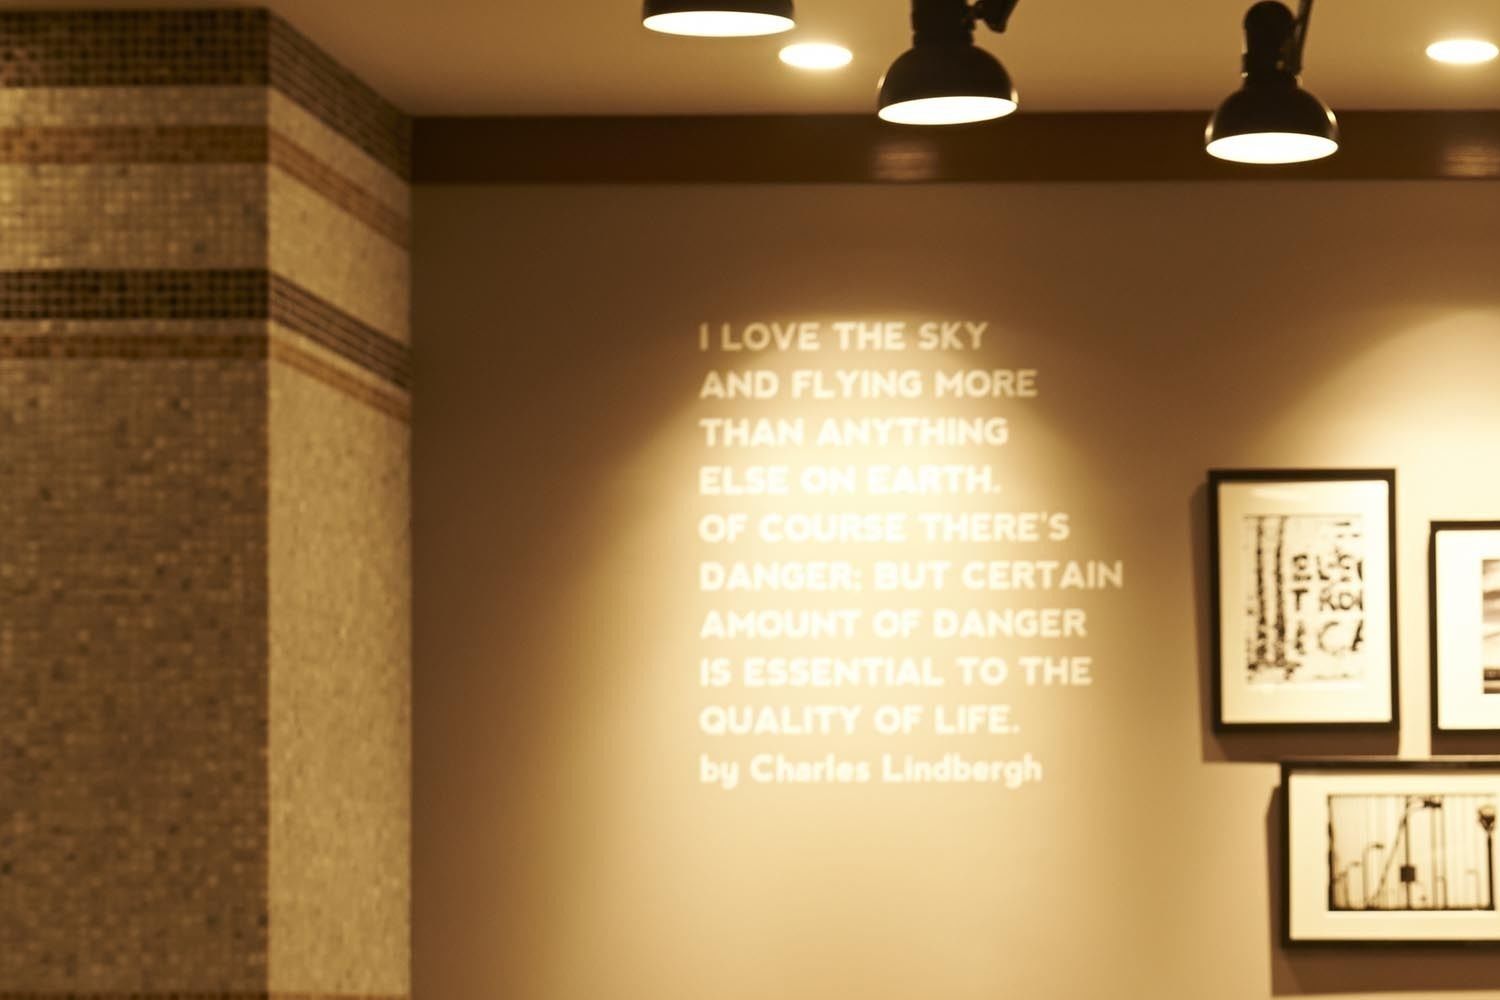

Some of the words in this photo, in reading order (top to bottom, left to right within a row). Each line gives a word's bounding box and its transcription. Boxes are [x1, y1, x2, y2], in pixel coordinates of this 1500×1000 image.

[699, 322, 709, 351] I
[721, 321, 821, 351] LOVE
[832, 320, 906, 352] THE
[918, 321, 989, 351] SKY
[700, 370, 780, 400] AND
[791, 368, 923, 400] FLYING
[934, 368, 1039, 398] MORE
[698, 416, 805, 448] THAN
[815, 416, 1009, 448] ANYTHING
[699, 464, 791, 497] ELSE
[798, 464, 857, 496] ON
[865, 463, 1001, 496] EARTH.
[697, 512, 749, 544] OF
[756, 511, 908, 545] COURSE
[916, 511, 1071, 543] THERE'S
[873, 559, 953, 591] BUT
[960, 559, 1124, 591] CERTAIN
[699, 608, 863, 640] AMOUNT
[871, 607, 924, 640] OF
[932, 607, 1088, 639] DANGER
[699, 656, 733, 688] IS
[743, 655, 945, 688] ESSENTIAL
[954, 656, 1009, 687] TO
[1017, 655, 1094, 687] THE
[698, 704, 862, 736] QUALITY
[872, 703, 924, 736] OF
[934, 704, 1022, 736] LIFE.
[699, 752, 740, 791] by
[748, 752, 871, 785] Charles
[881, 752, 1044, 790] Lindbergh
